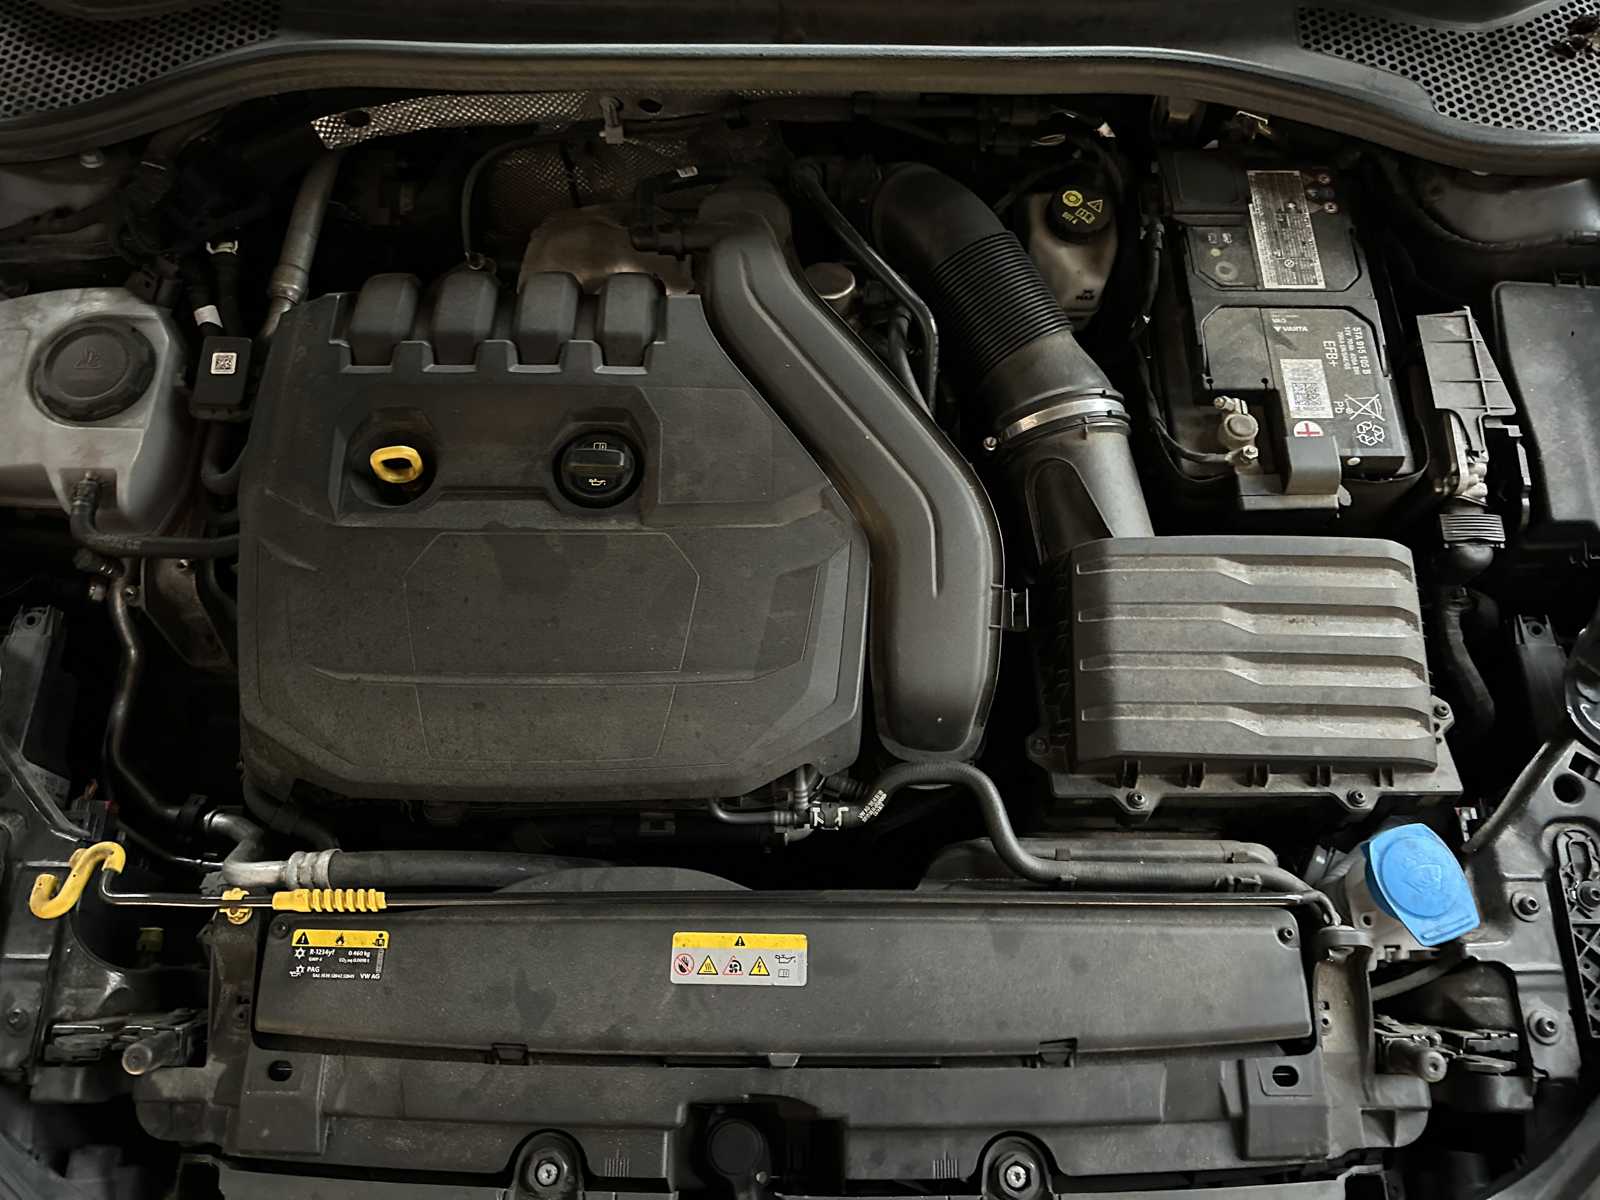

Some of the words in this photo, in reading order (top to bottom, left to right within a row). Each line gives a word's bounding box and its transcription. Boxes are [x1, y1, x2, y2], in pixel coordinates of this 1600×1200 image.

[1323, 340, 1339, 367] EFB+
[1356, 341, 1367, 354] 915
[1333, 401, 1345, 414] Pb
[309, 948, 335, 957] R-1234yf
